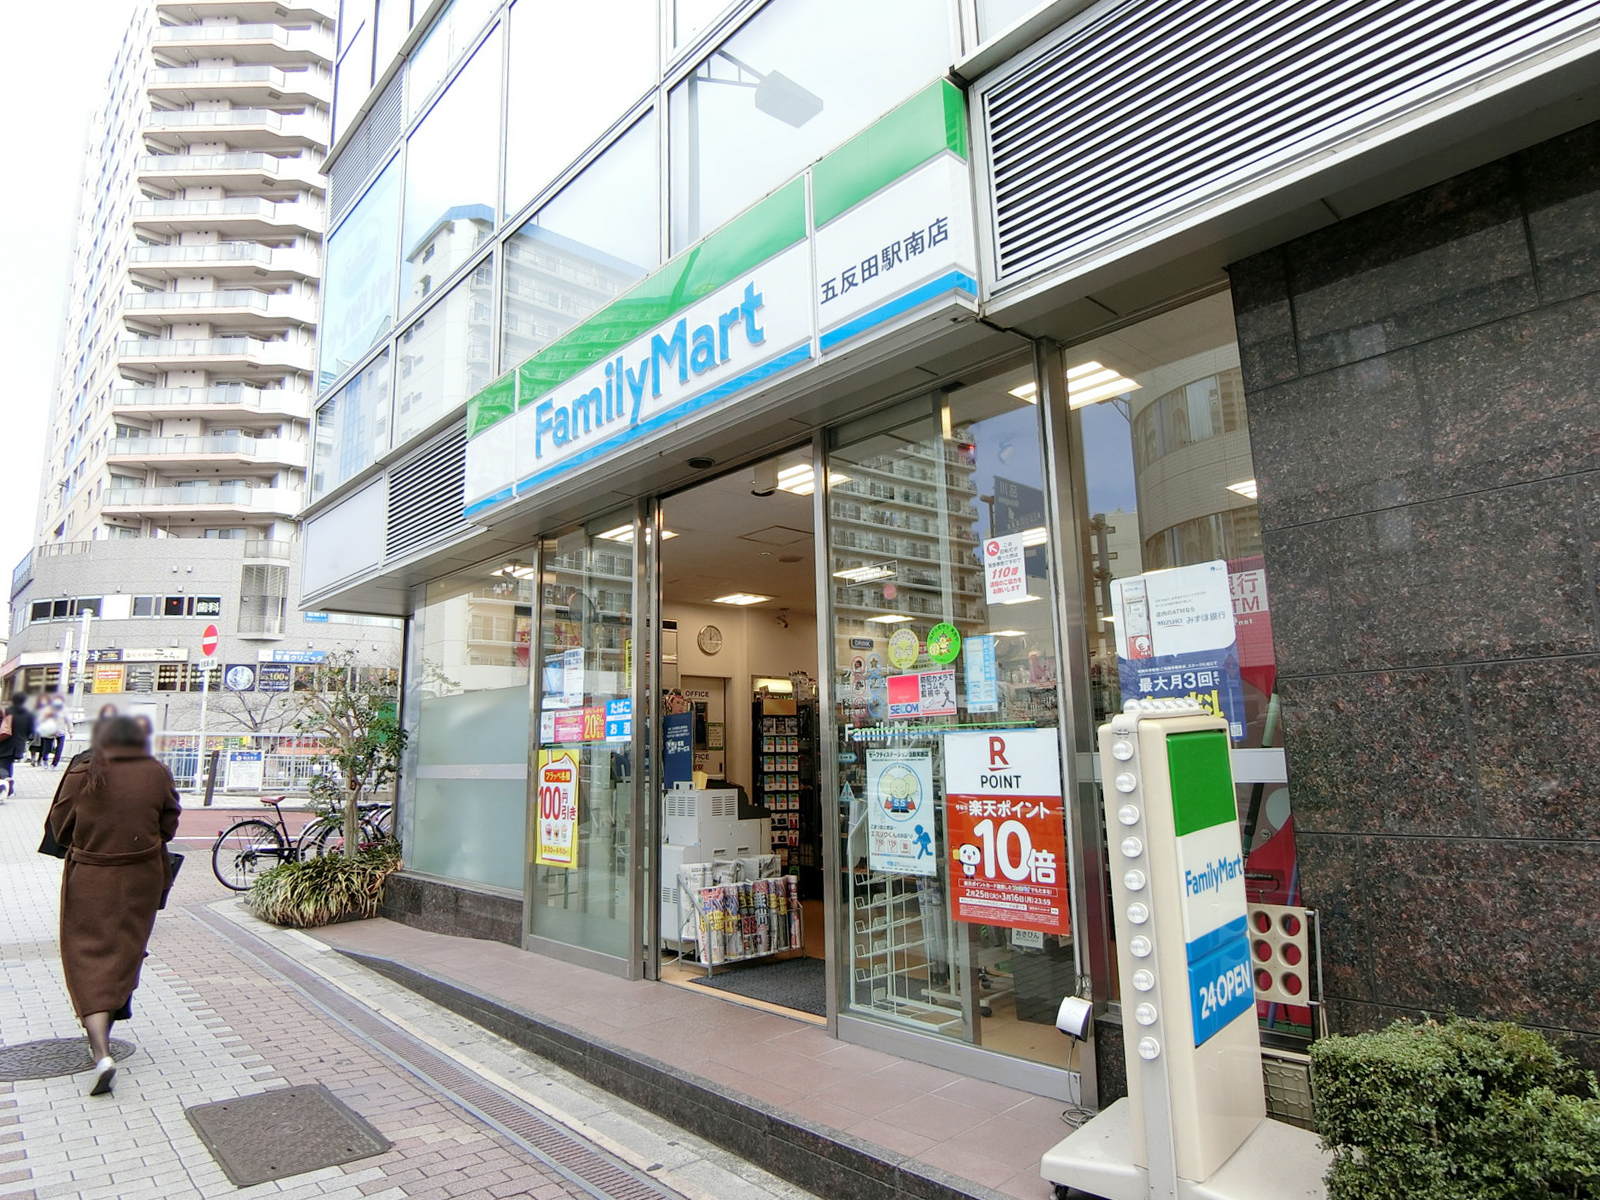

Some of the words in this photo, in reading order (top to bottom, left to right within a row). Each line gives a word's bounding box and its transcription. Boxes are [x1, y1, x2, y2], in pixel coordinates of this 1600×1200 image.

[820, 215, 949, 305] 五反田駅南店
[535, 280, 766, 459] FamilyMart
[992, 566, 1019, 579] 110番
[993, 584, 1020, 594] お願いします
[197, 602, 219, 613] 歯科
[1231, 596, 1259, 613] TM
[1157, 617, 1183, 626] MIZUHO
[1186, 611, 1226, 625] みずほ銀行
[921, 673, 954, 683] 防犯カメラで
[921, 682, 945, 690] セコムが
[685, 690, 710, 698] OFFICE
[921, 689, 941, 698] 監視中
[610, 701, 631, 714] たばこ
[890, 703, 919, 714] SECOM
[845, 721, 934, 746] FamilyMart
[693, 753, 710, 761] FICE
[989, 736, 1009, 765] R
[980, 775, 1021, 789] POINT
[969, 800, 1051, 819] 楽天ポイント
[973, 818, 1057, 884] 10倍
[1185, 853, 1243, 897] FamilyMart
[1016, 930, 1039, 940] あきびん
